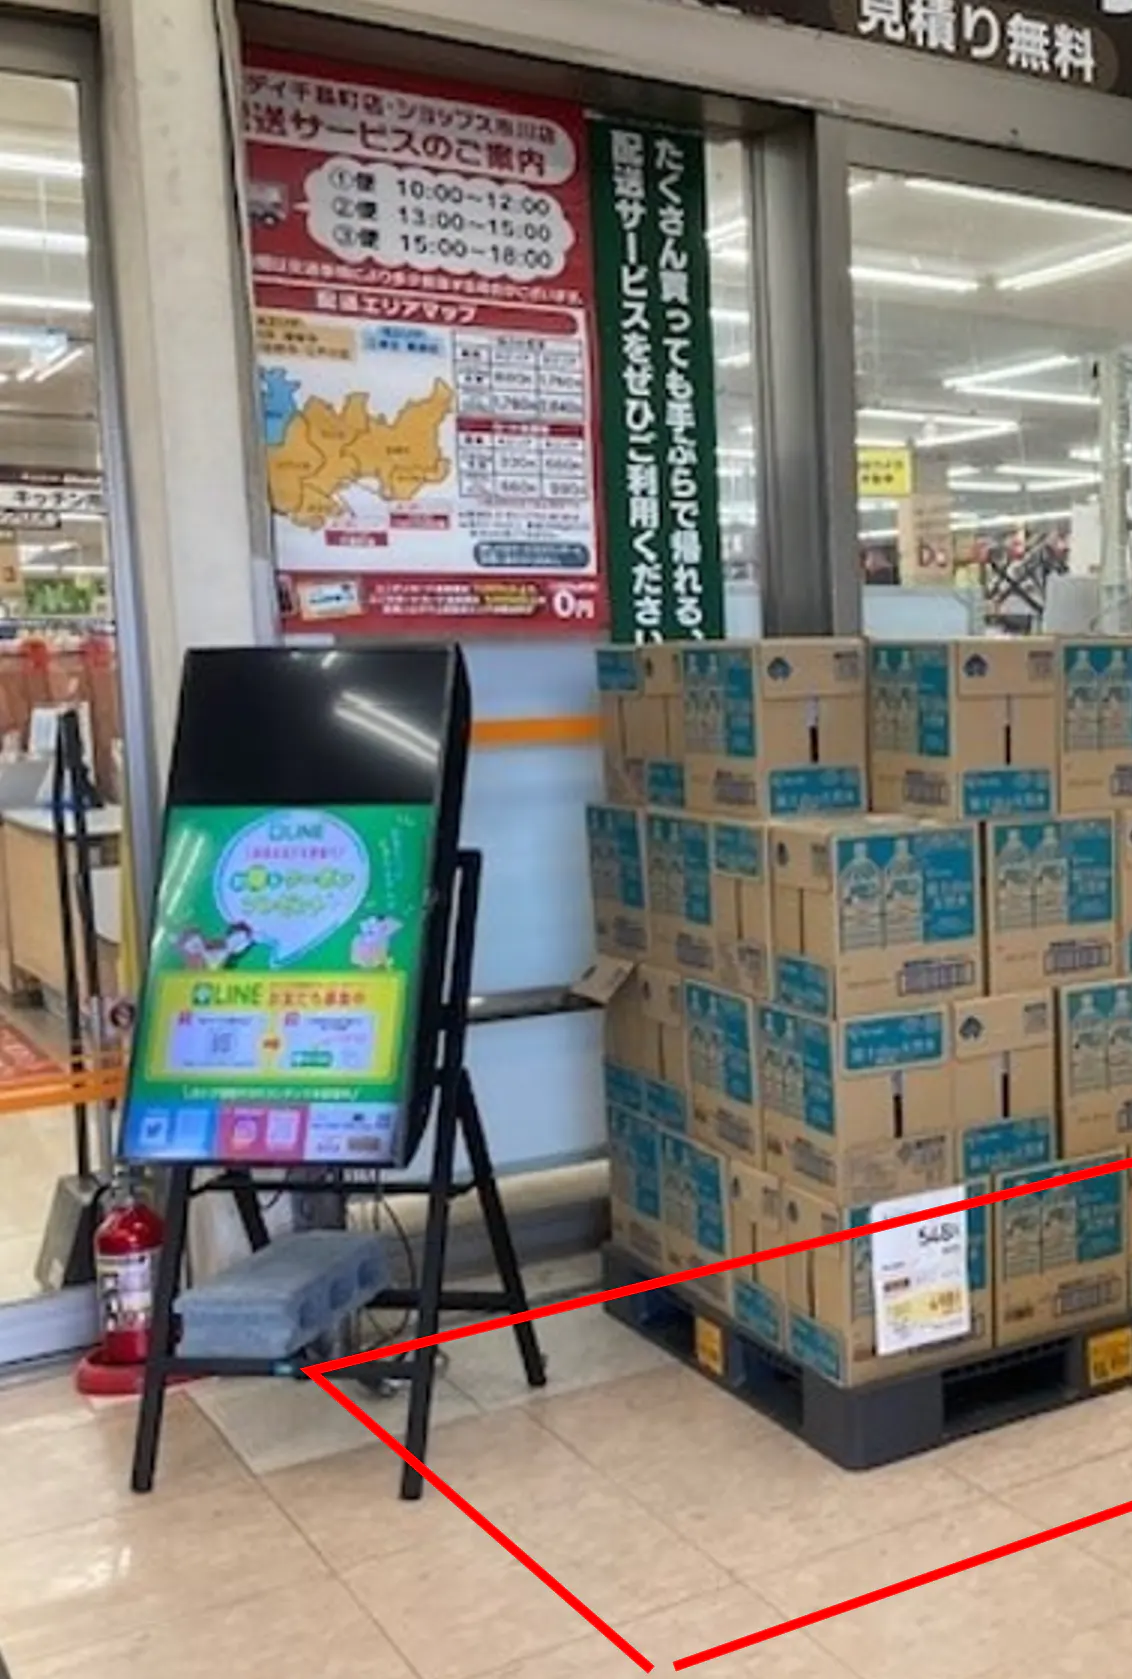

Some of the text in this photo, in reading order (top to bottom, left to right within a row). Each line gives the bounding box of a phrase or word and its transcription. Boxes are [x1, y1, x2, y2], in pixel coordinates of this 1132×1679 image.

[858, 0, 1096, 82] 見積り無料
[244, 101, 546, 177] 送サービスのご案内
